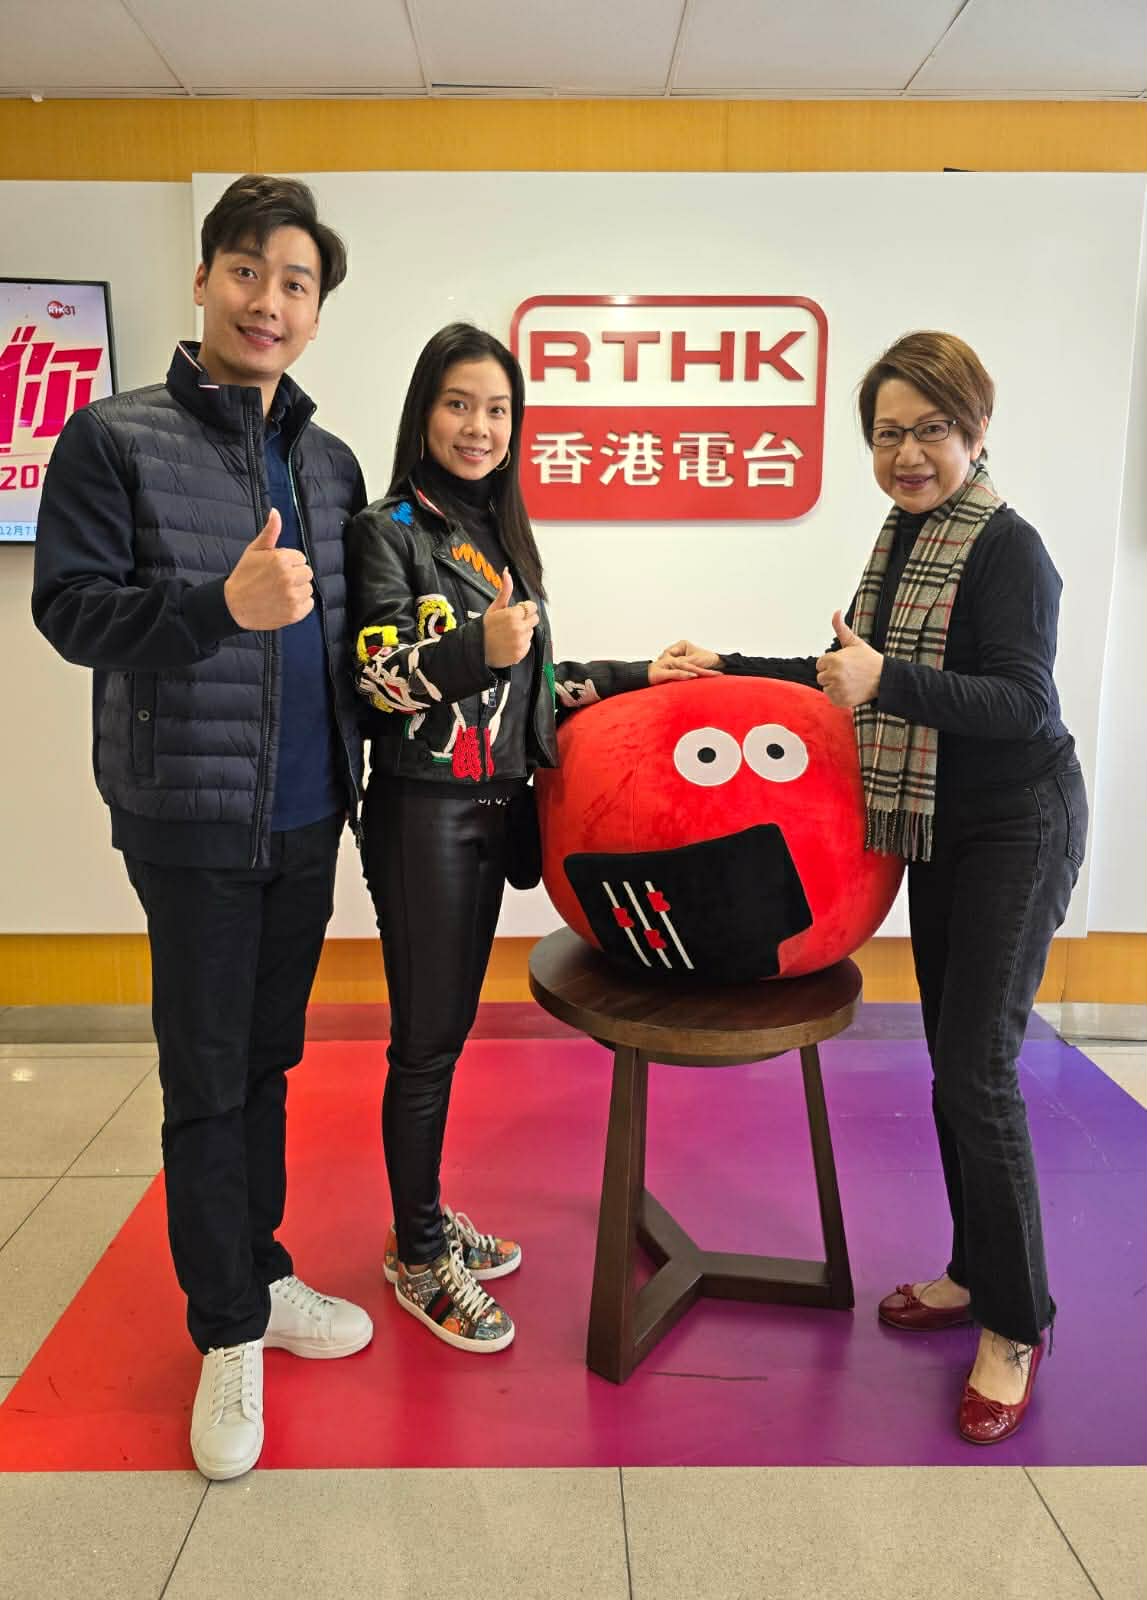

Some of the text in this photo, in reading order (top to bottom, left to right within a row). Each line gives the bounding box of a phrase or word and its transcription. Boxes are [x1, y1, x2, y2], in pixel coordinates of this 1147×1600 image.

[529, 330, 807, 382] RTHK
[0, 464, 48, 491] 20
[530, 431, 804, 488] 香港電台
